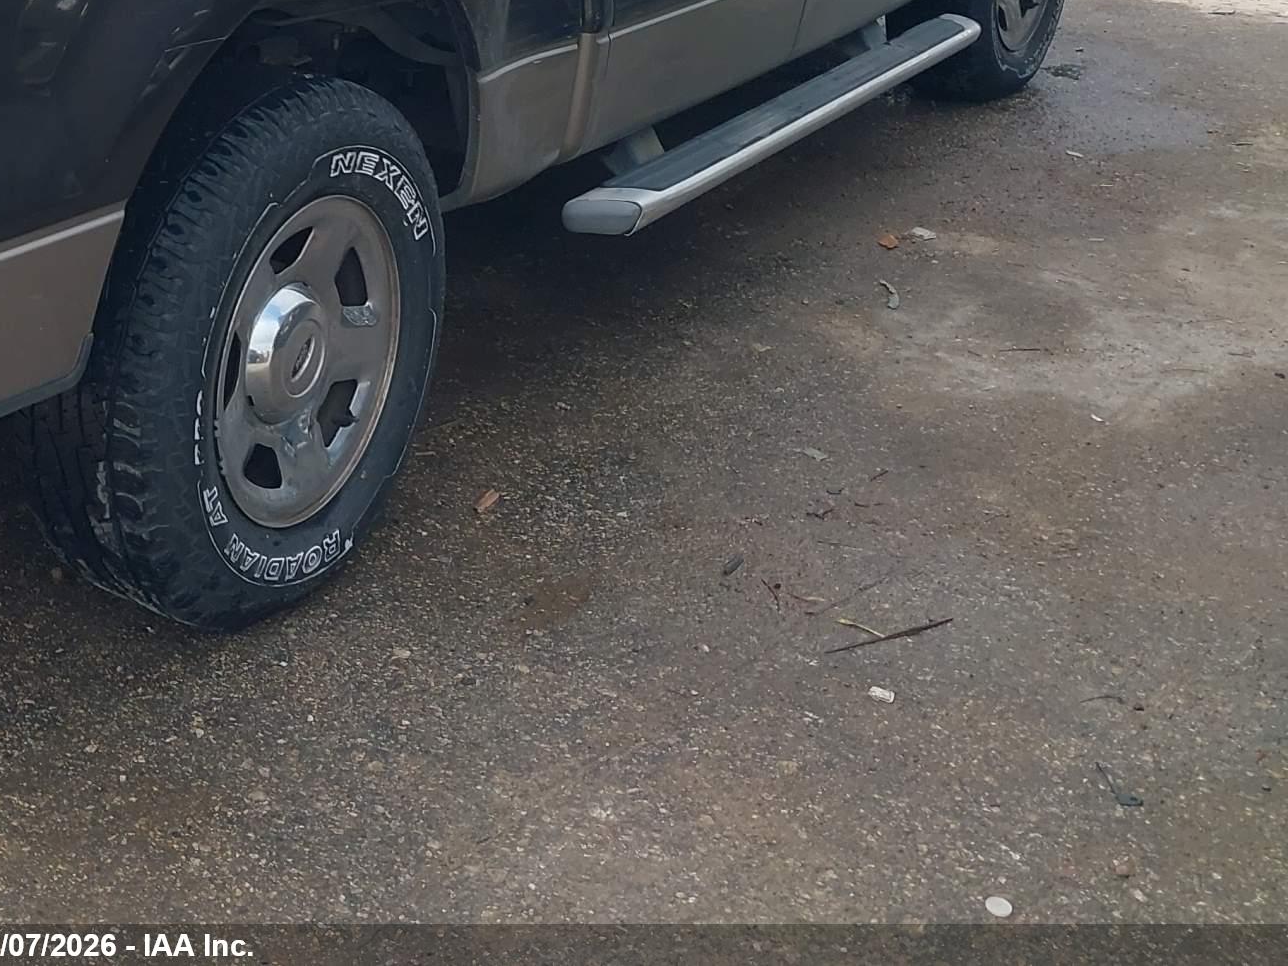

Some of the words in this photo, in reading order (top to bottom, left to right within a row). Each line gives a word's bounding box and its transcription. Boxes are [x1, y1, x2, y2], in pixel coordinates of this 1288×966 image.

[329, 151, 429, 241] NEXEN
[202, 485, 229, 527] AT
[223, 529, 340, 582] ROADIAN
